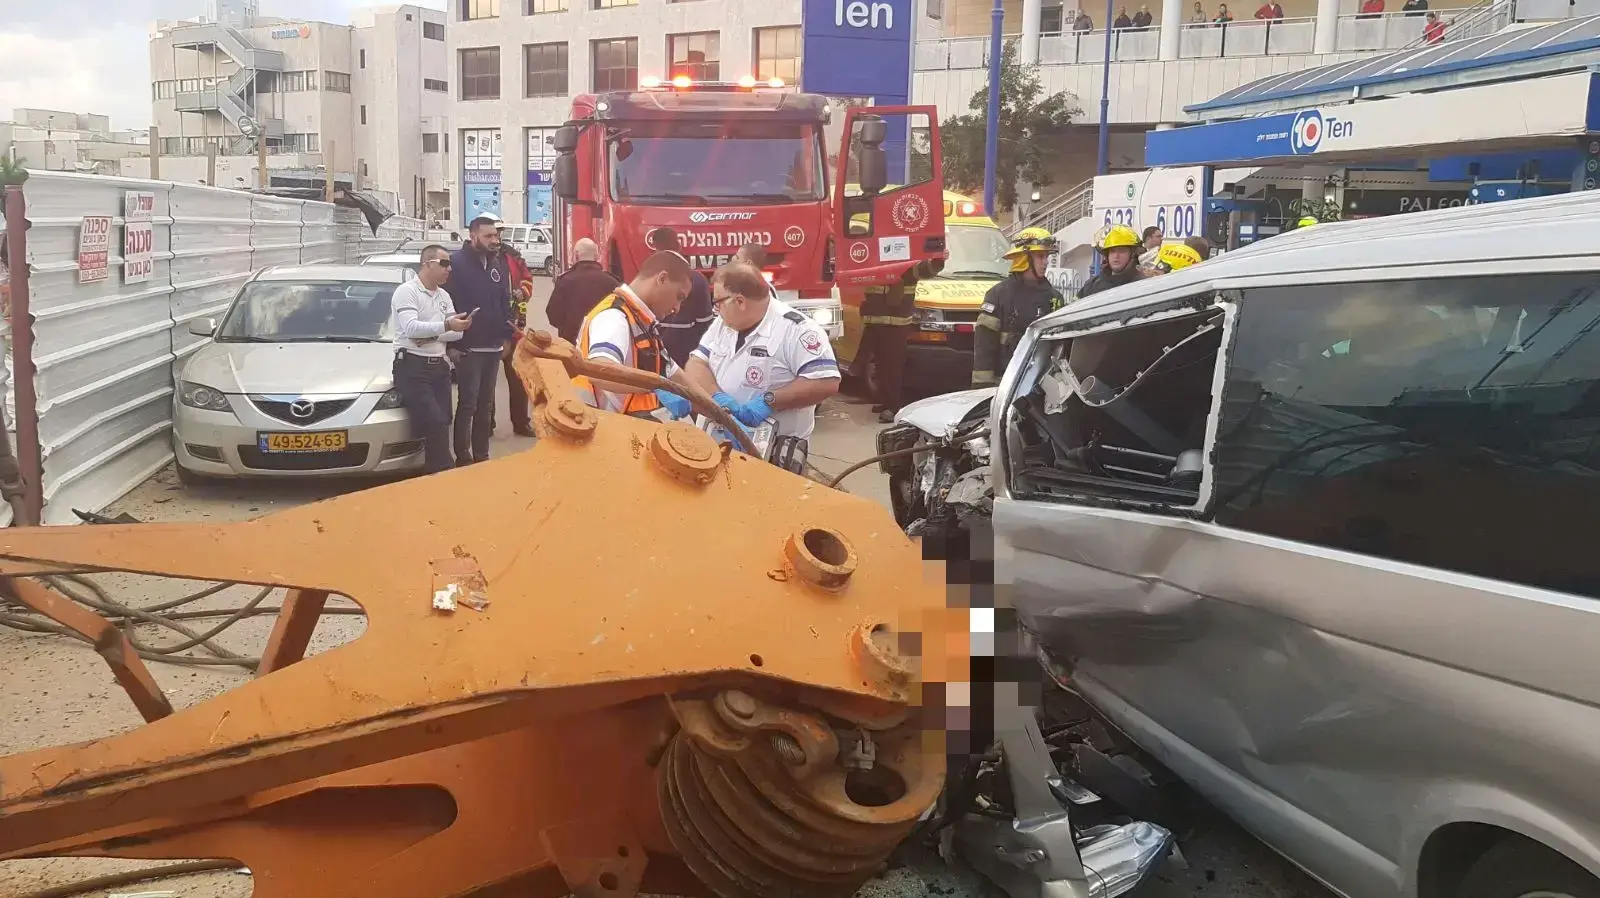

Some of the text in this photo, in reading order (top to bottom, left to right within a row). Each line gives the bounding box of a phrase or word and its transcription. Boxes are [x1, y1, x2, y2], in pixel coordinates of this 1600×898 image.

[1326, 118, 1353, 138] Ten
[708, 212, 757, 221] carmor
[1157, 205, 1194, 238] 6.00
[84, 219, 108, 234] סכנה
[126, 226, 152, 255] סכנה!
[677, 229, 772, 248] כבאות והצלה
[787, 233, 800, 242] 407
[852, 249, 866, 258] 407
[689, 254, 729, 270] IVE
